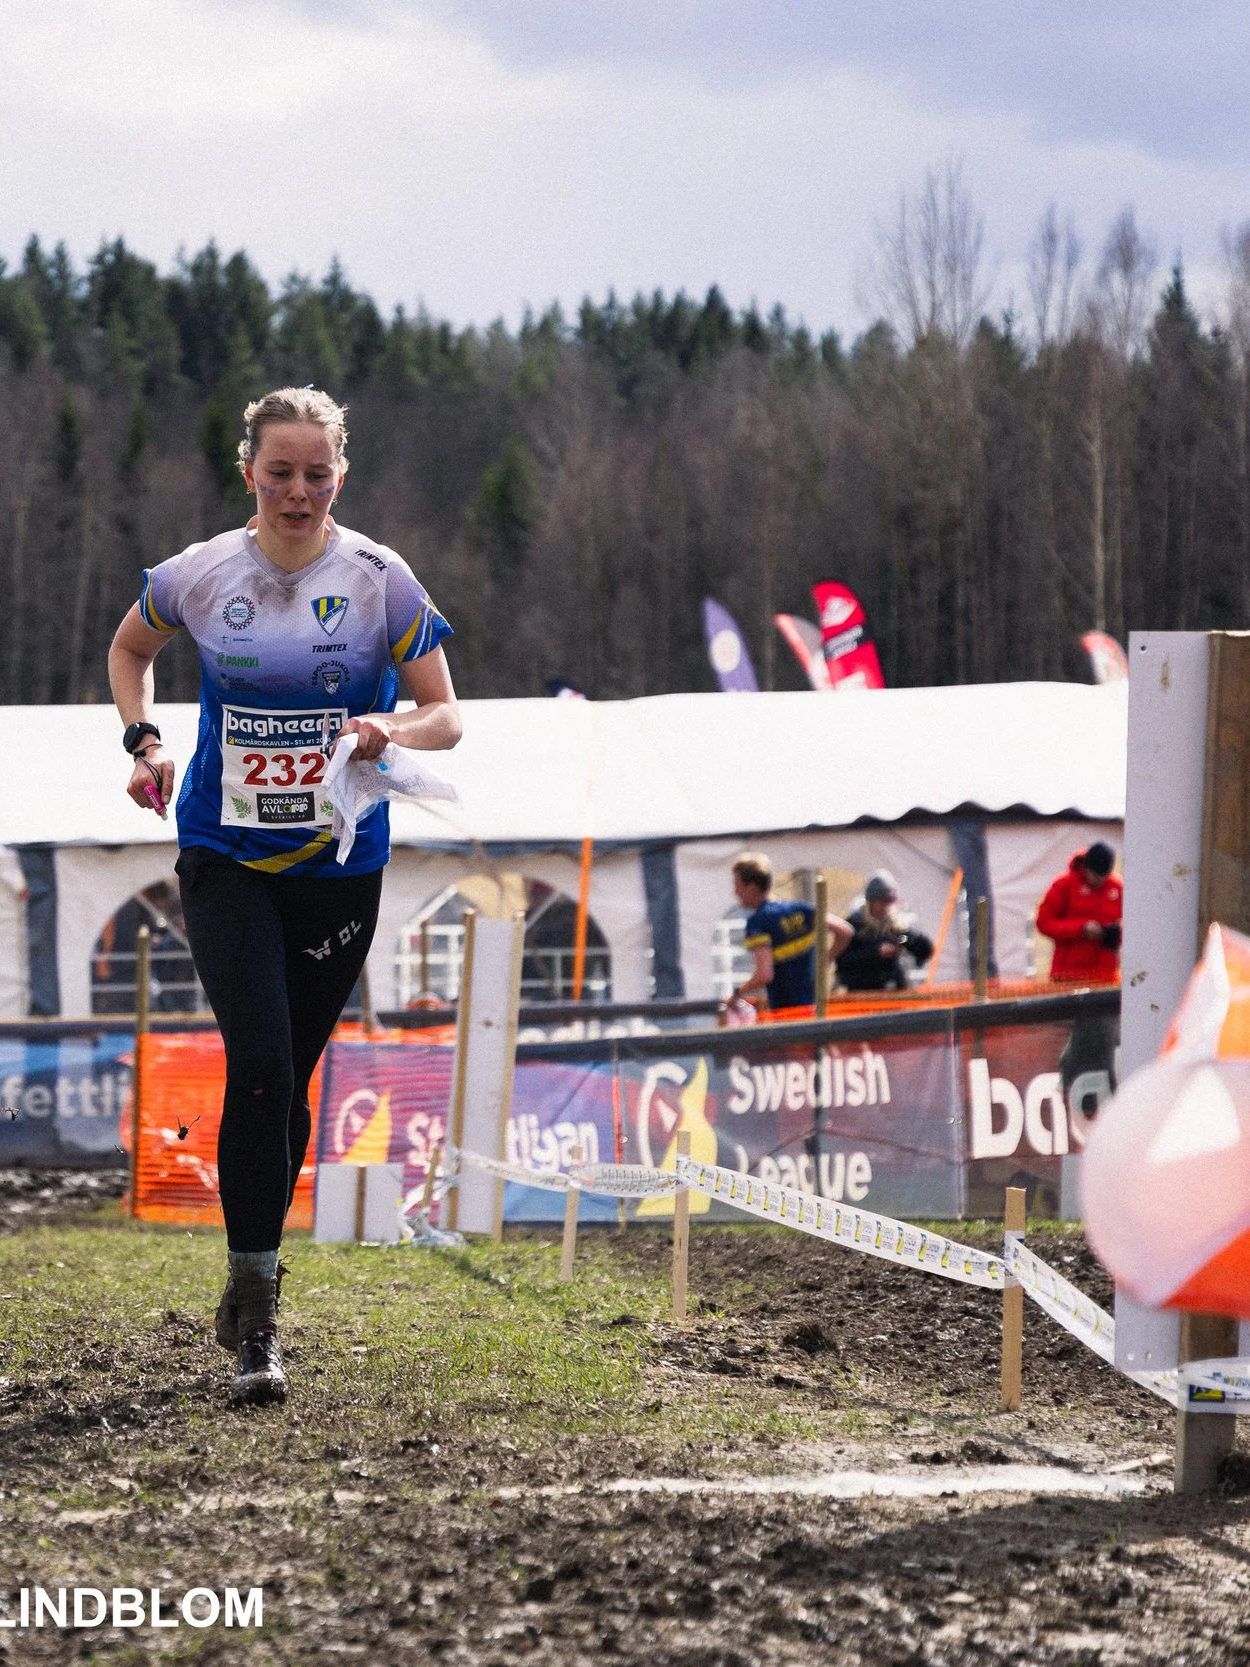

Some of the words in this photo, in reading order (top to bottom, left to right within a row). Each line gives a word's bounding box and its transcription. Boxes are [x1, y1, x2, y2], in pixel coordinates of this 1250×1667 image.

[355, 549, 387, 571] TRIMTEX
[312, 643, 348, 653] TRIMTEX
[226, 655, 259, 668] PANKKI
[228, 712, 341, 737] bagheera
[234, 738, 290, 747] KOLMÅRDSKAVLEN
[242, 753, 326, 787] 232
[261, 795, 309, 805] GODKÄNDA
[729, 1042, 891, 1115] Swedish
